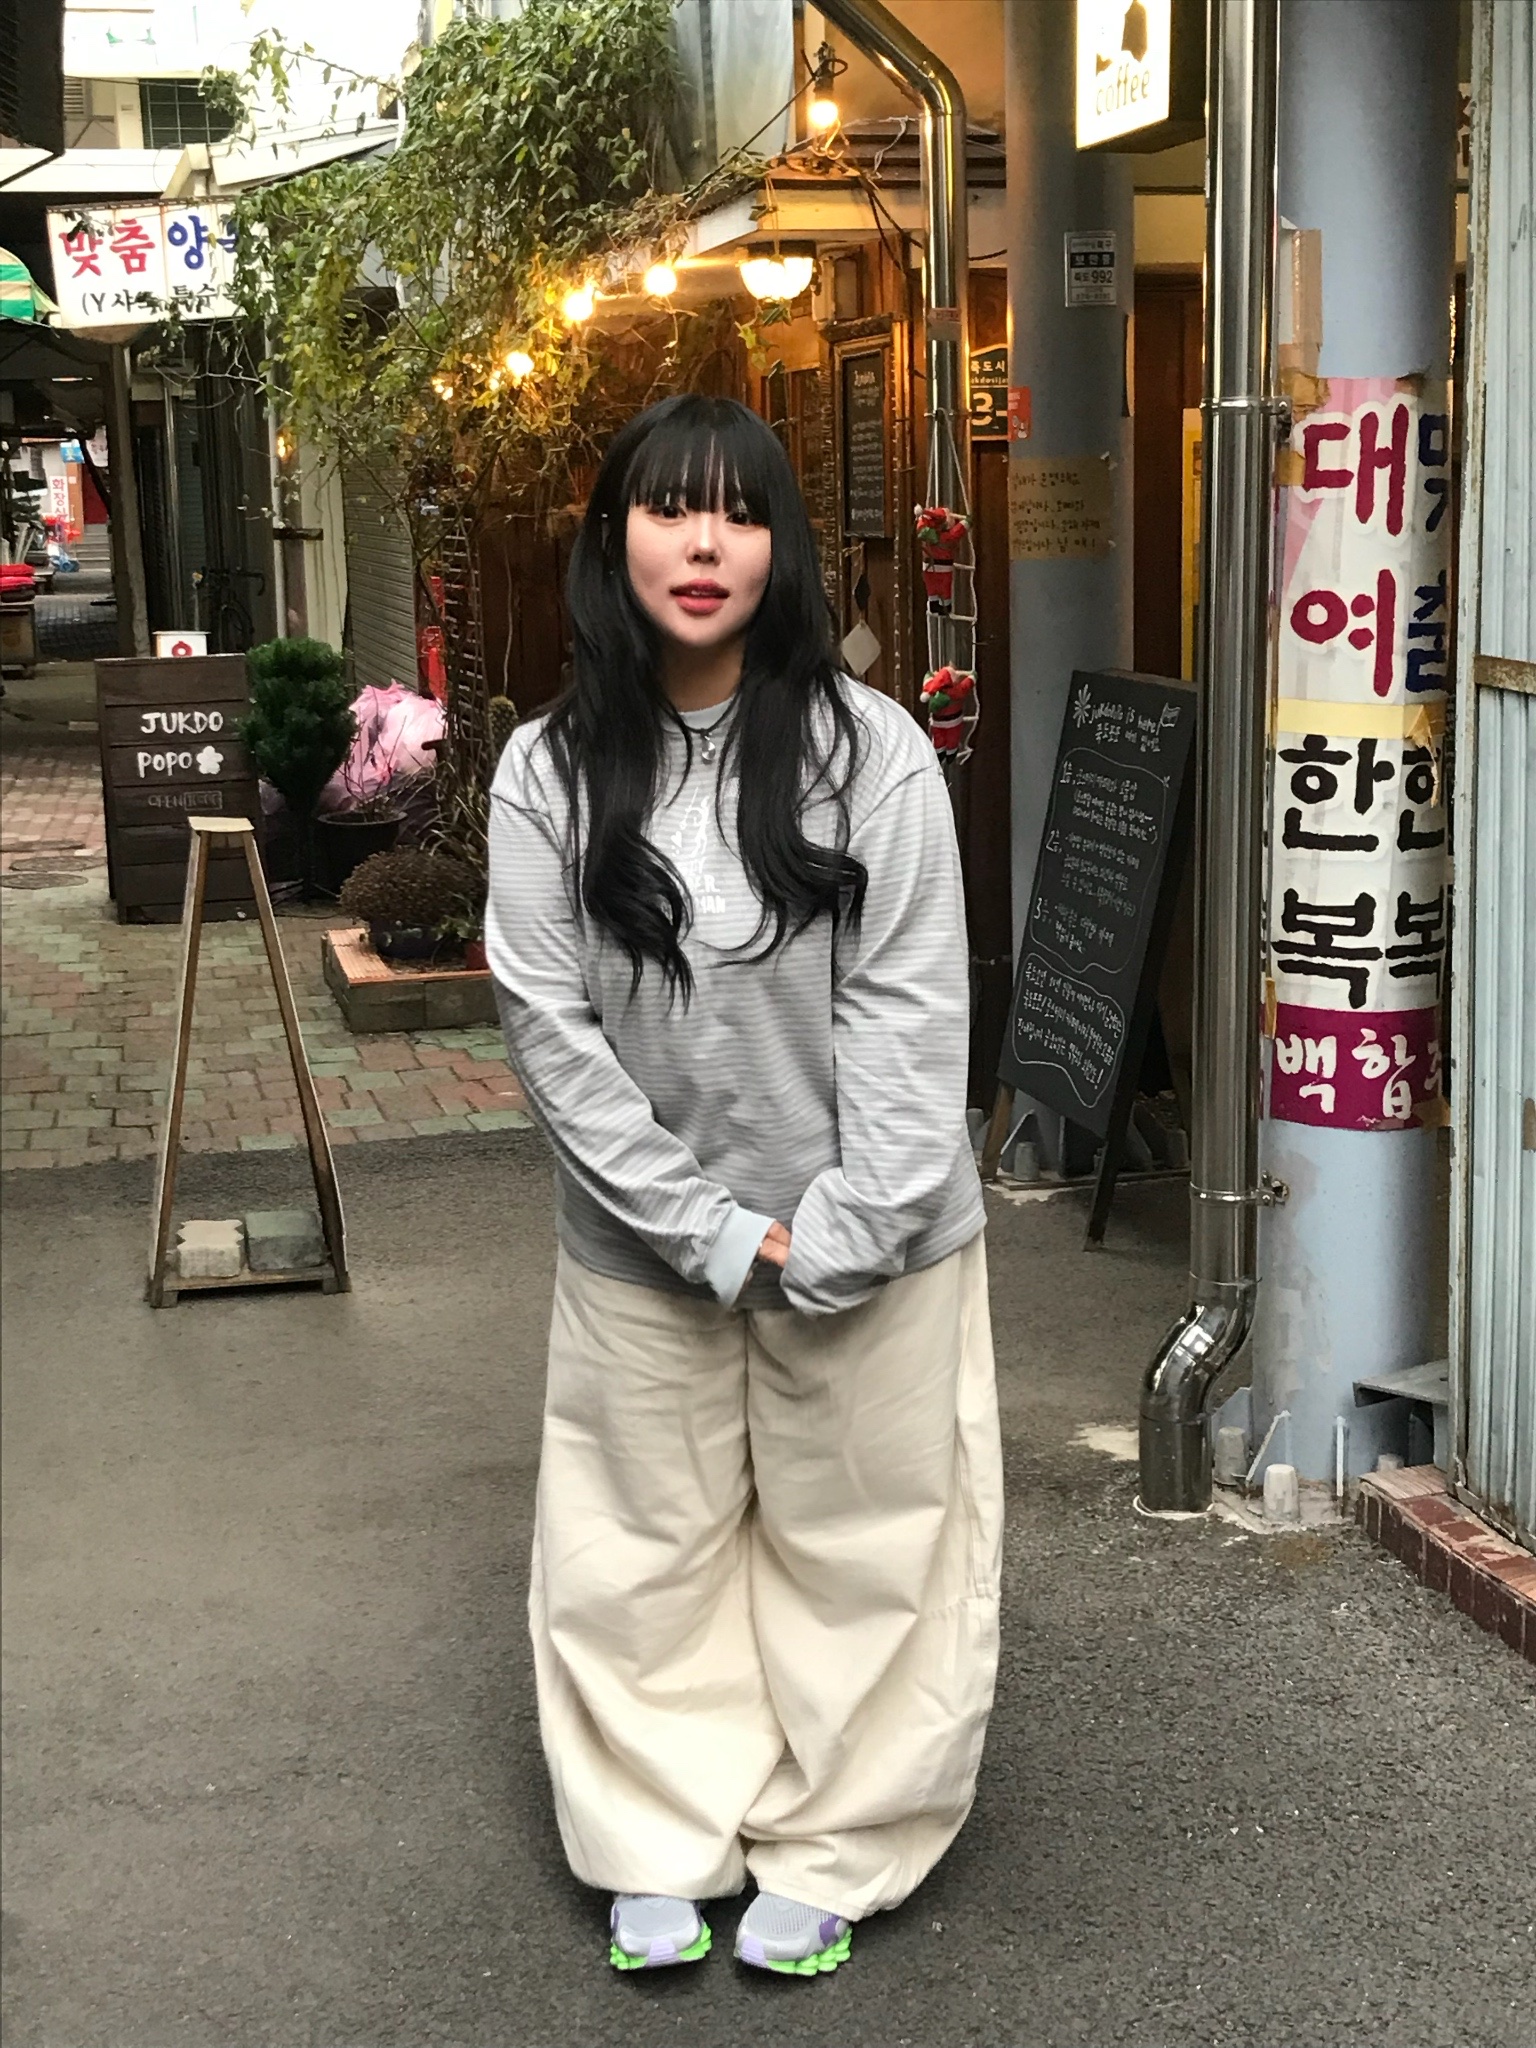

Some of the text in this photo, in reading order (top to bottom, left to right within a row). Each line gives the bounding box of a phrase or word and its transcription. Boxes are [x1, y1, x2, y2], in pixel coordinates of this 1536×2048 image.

[1096, 62, 1150, 116] coffee
[1091, 270, 1113, 284] 992
[1126, 706, 1136, 724] is
[1137, 714, 1157, 734] here
[1272, 403, 1410, 1010] 대여 한복
[140, 711, 224, 734] JUKDO
